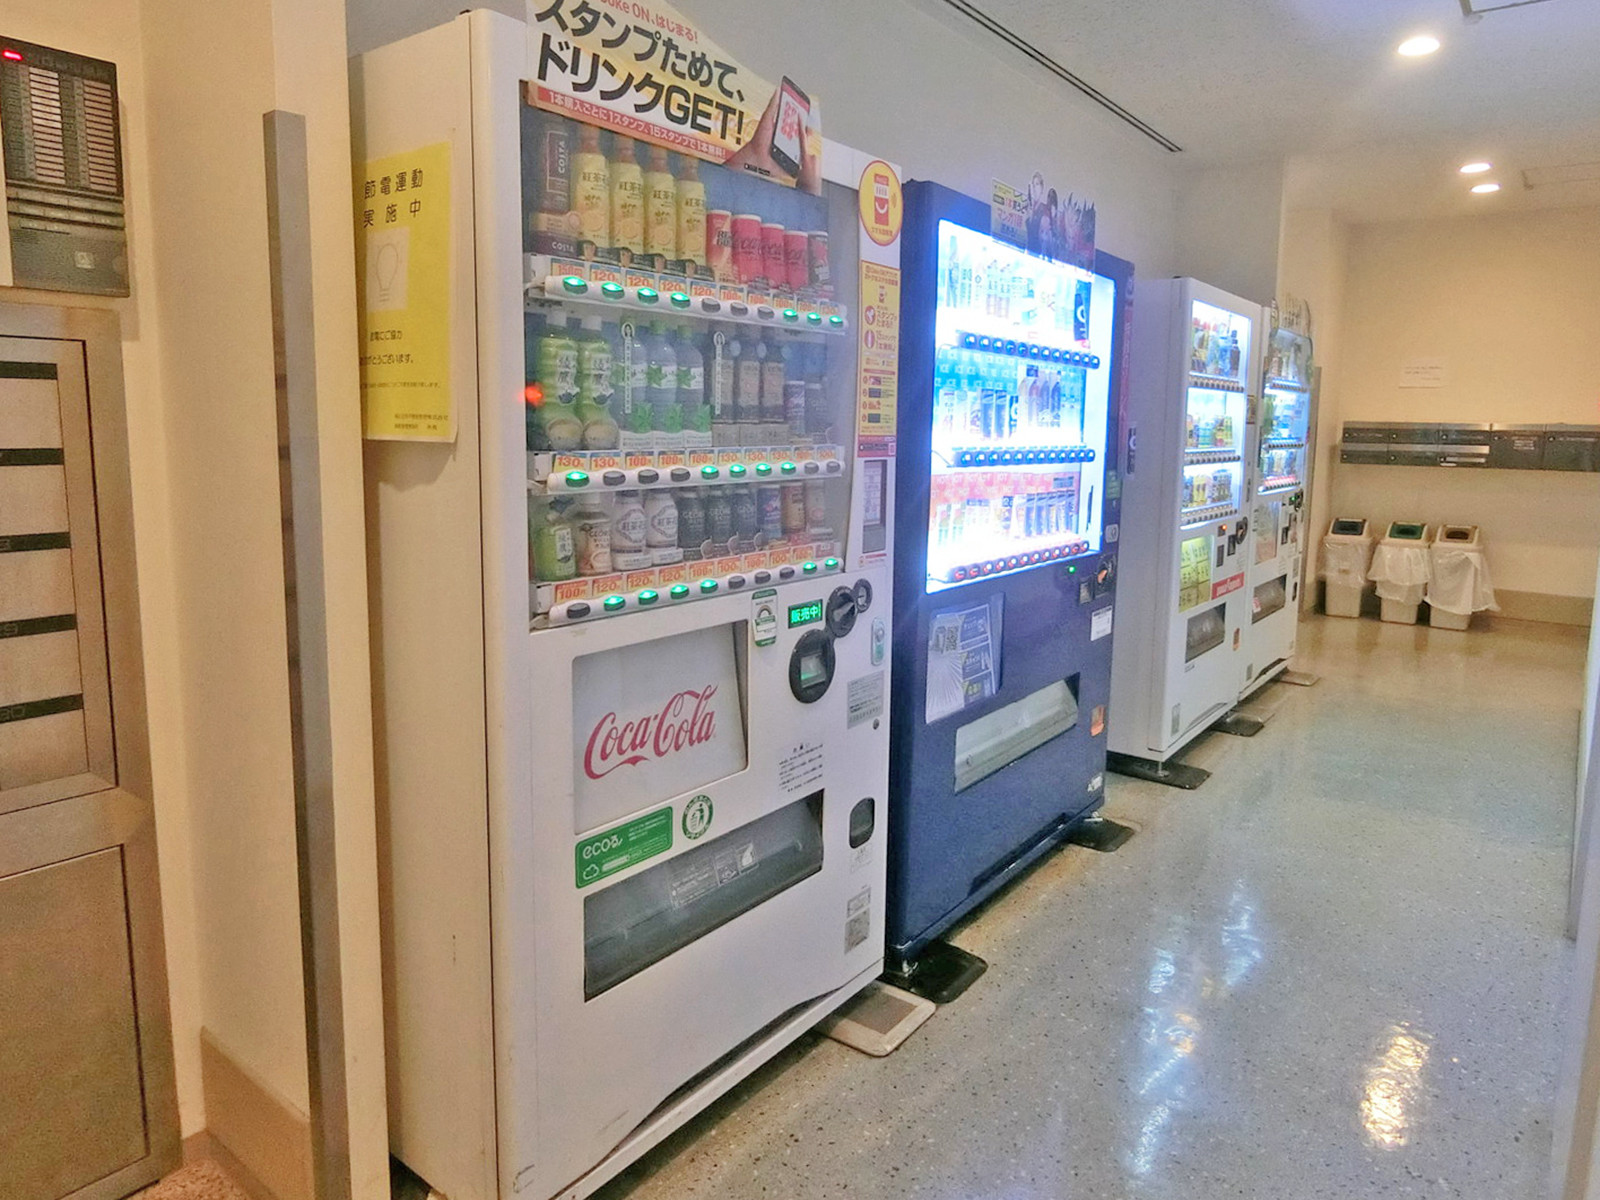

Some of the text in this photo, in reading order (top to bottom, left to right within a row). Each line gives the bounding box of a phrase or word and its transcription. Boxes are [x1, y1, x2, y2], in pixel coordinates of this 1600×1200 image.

[537, 33, 745, 146] ドリンクGET!
[363, 198, 421, 228] 実施中
[552, 241, 575, 253] COSTA
[584, 684, 718, 780] Coca-Cola
